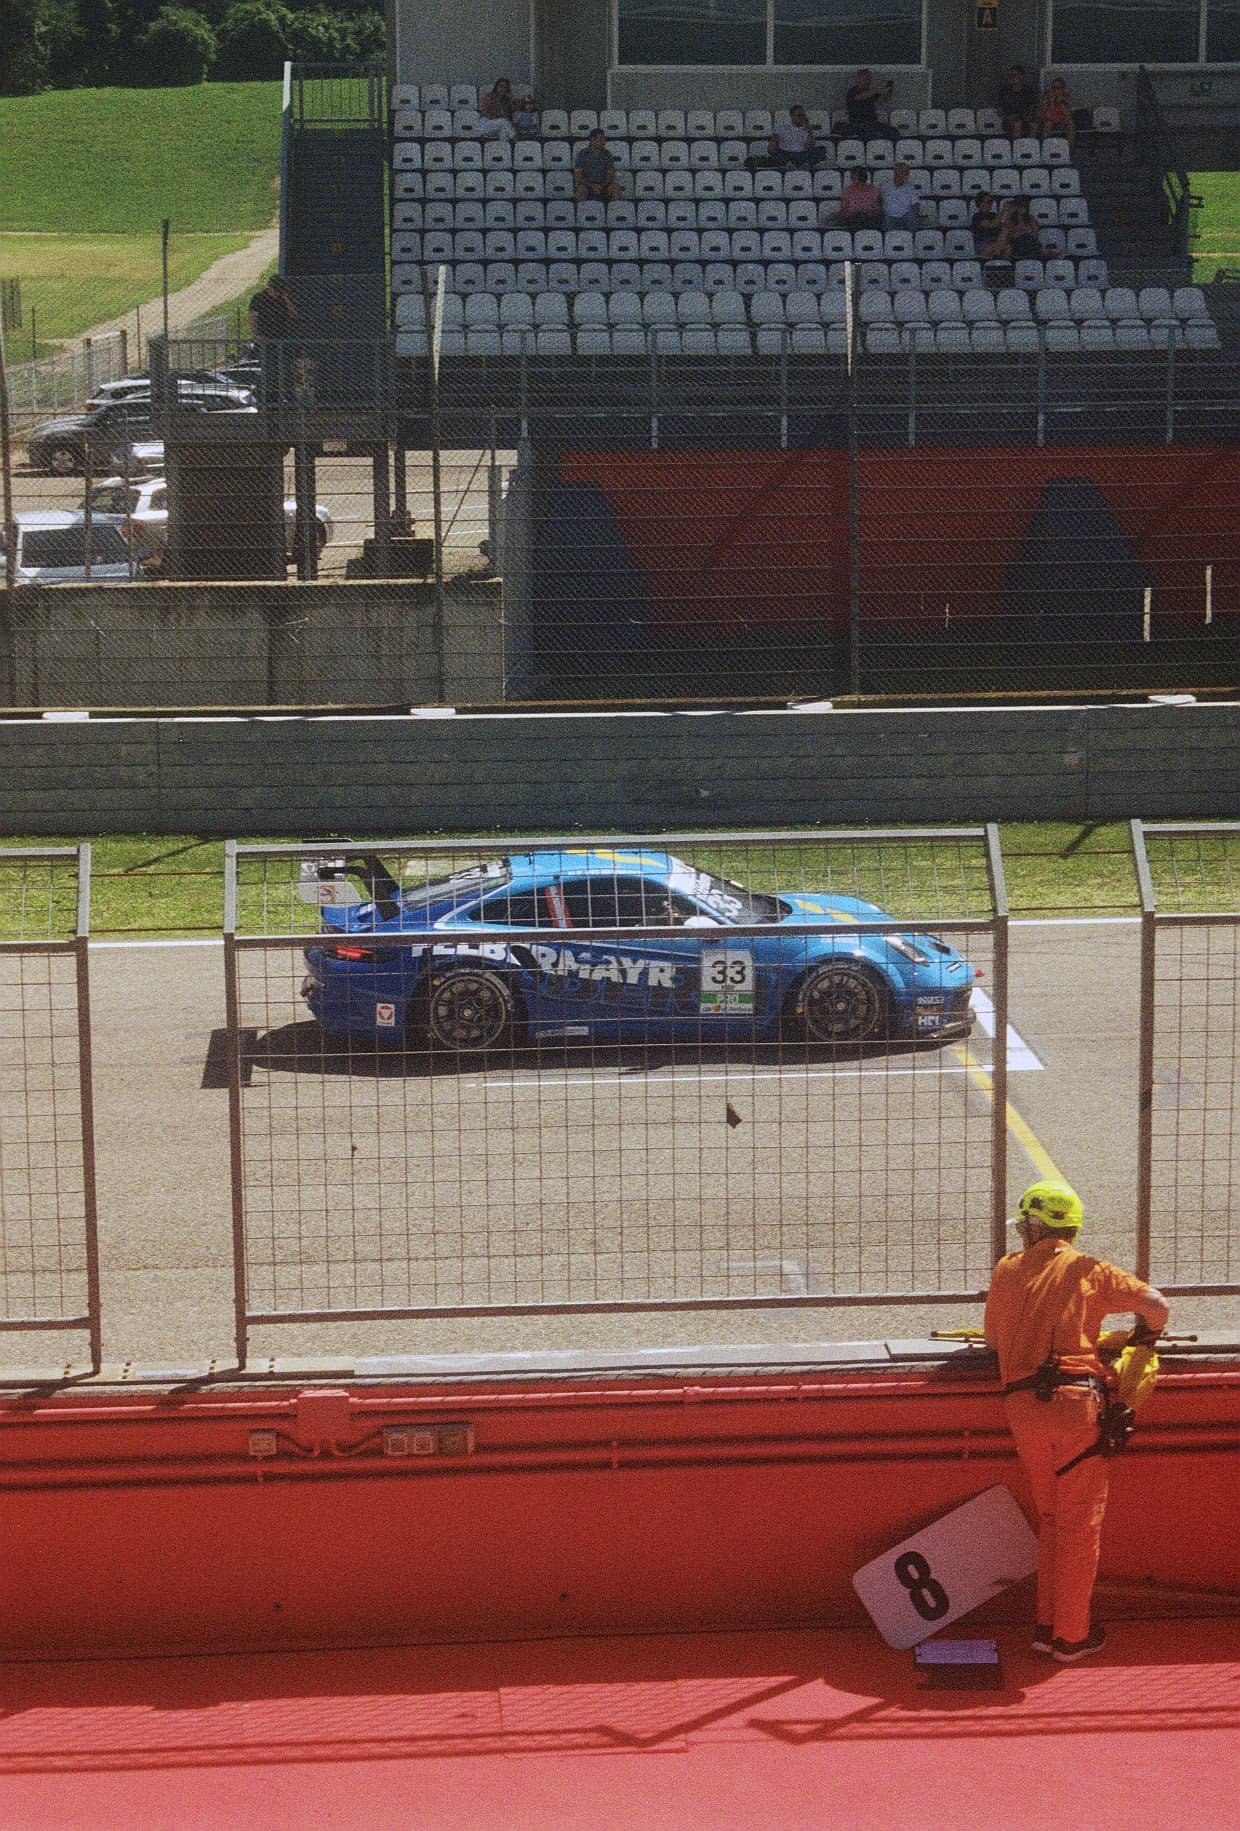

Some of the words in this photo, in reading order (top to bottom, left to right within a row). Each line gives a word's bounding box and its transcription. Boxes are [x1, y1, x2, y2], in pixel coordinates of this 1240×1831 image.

[982, 9, 993, 24] A
[711, 960, 746, 984] 33
[895, 1551, 950, 1621] 8
